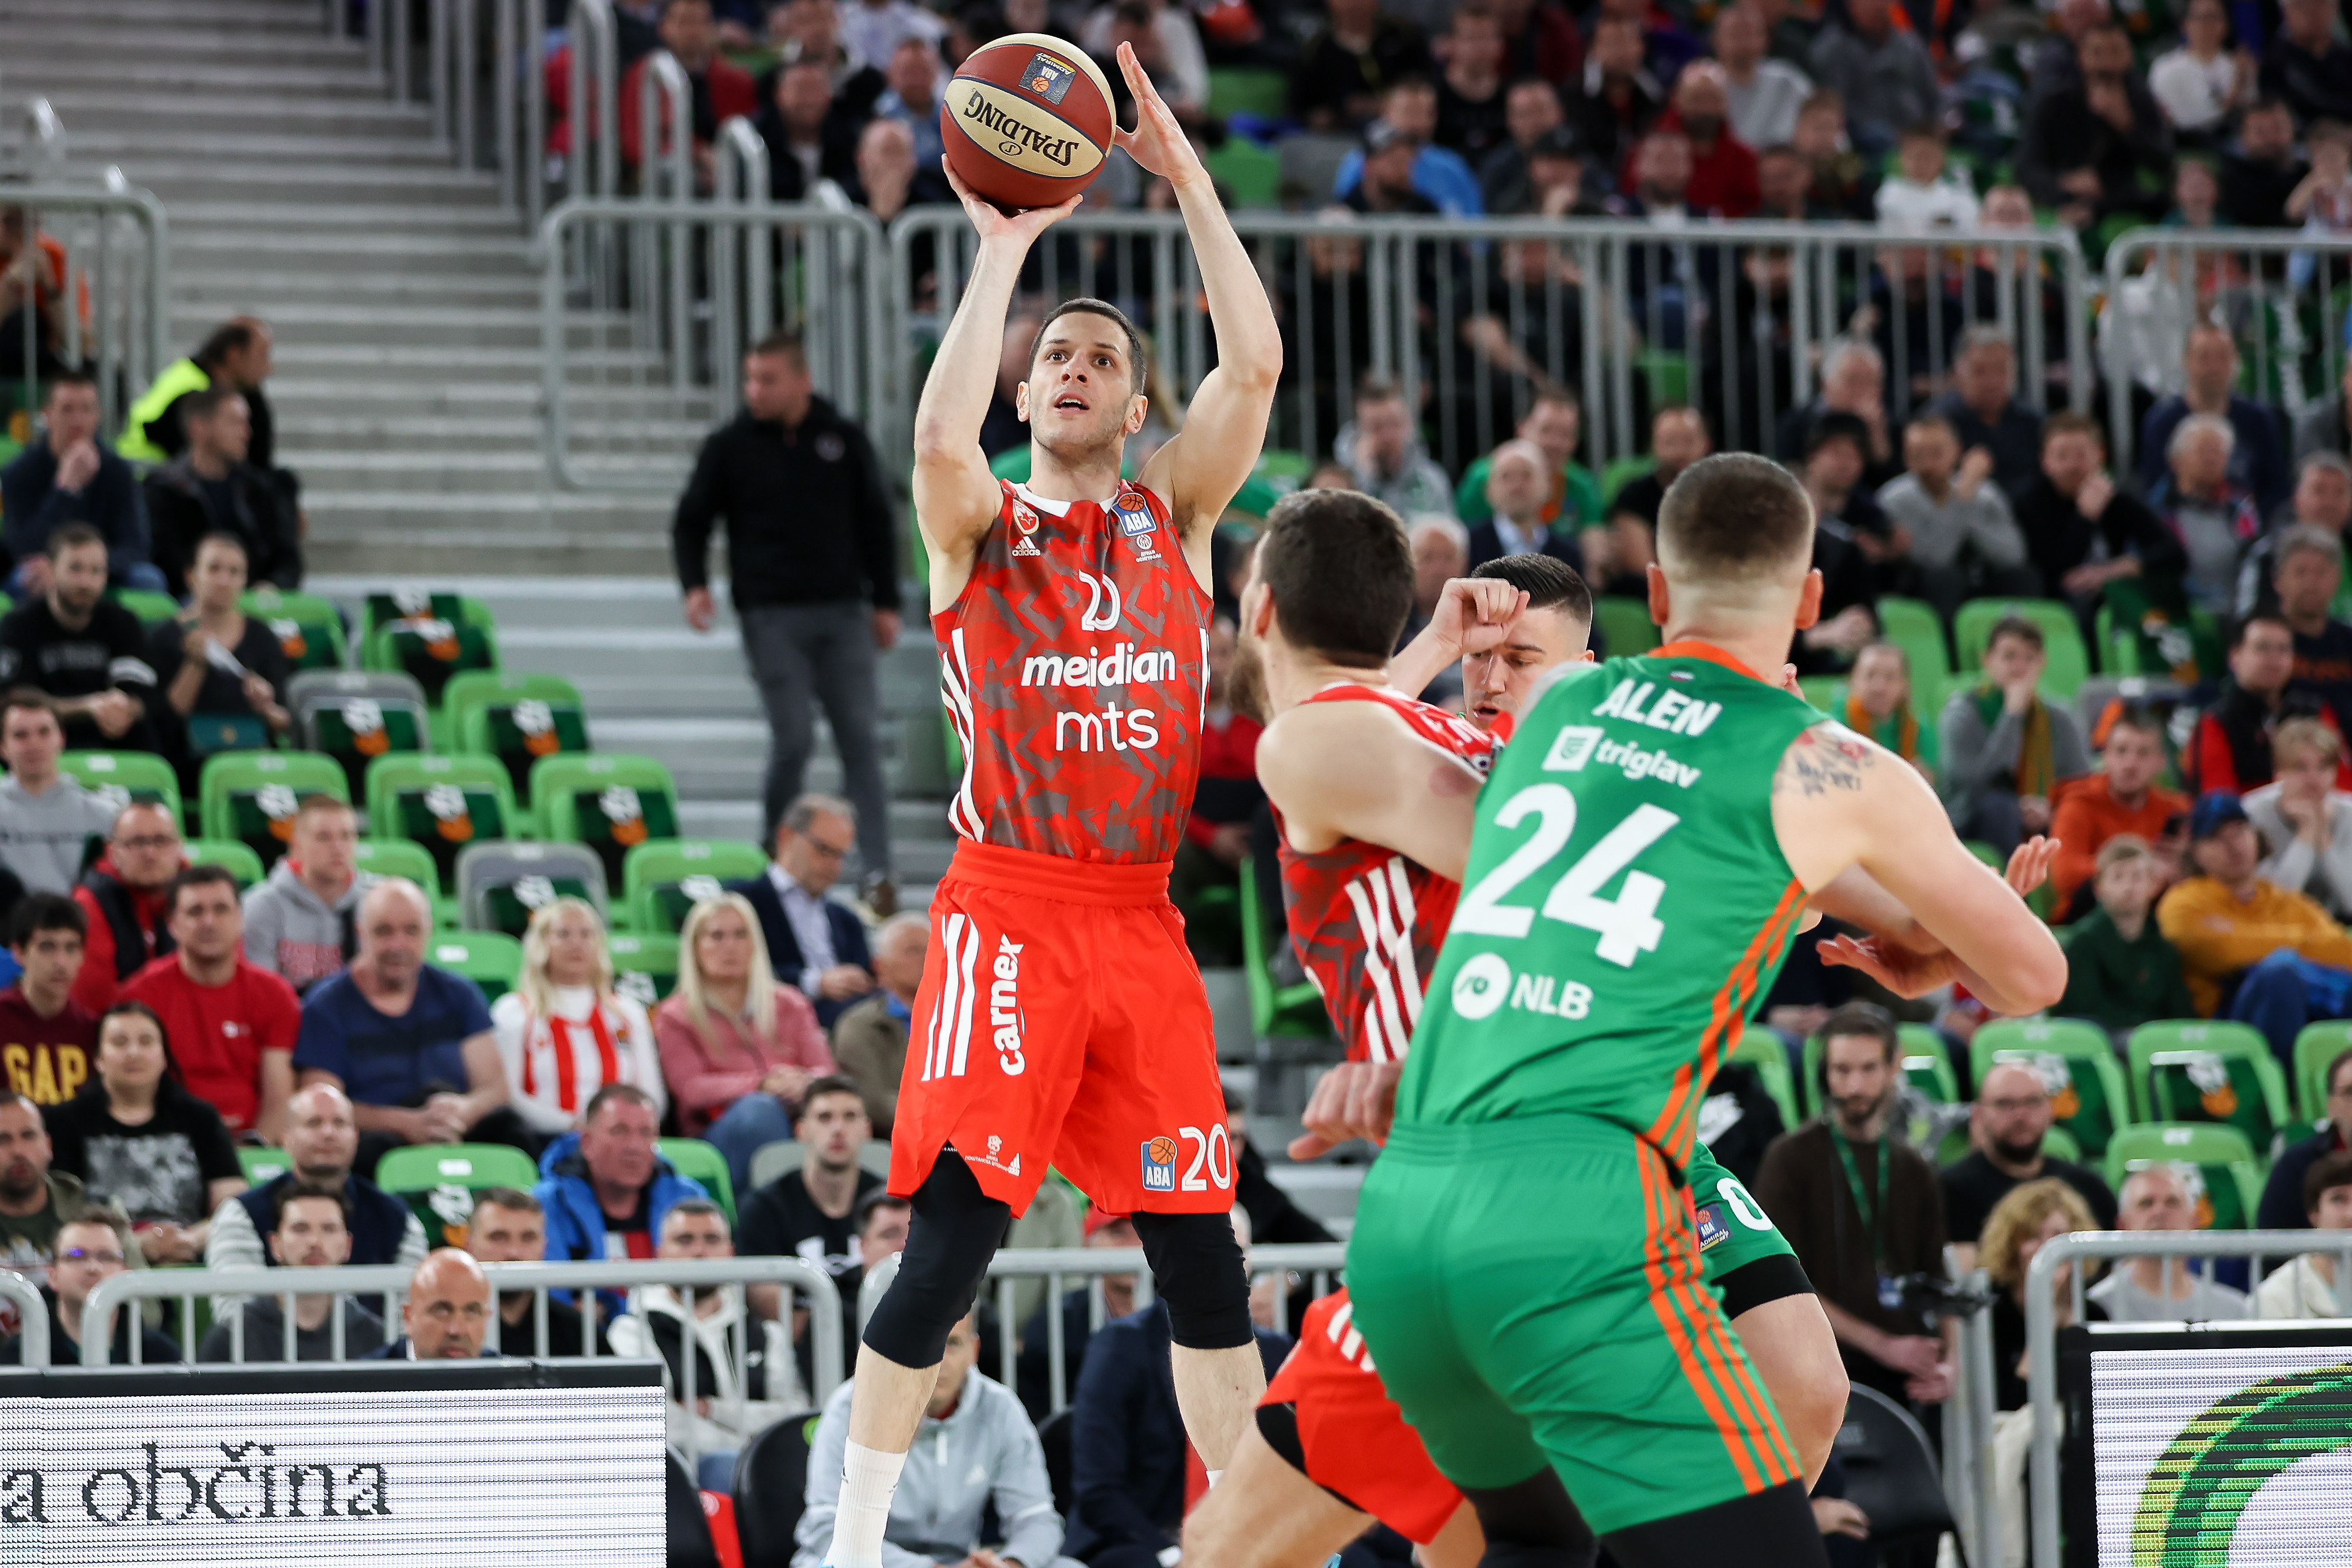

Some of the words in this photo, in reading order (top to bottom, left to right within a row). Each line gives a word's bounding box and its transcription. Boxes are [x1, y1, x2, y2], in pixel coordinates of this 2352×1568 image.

[1036, 56, 1072, 75] ADMIRAL
[1041, 66, 1059, 81] ABA
[963, 88, 1079, 167] SPALDING
[1124, 512, 1153, 532] ABA
[1021, 641, 1176, 687] meidian
[1055, 701, 1159, 752] mts
[1591, 678, 1723, 736] ALEN
[1595, 738, 1701, 788] triglav
[1448, 782, 1680, 968] 24
[990, 933, 1024, 1075] carnex
[1509, 972, 1594, 1021] NLB
[3, 1042, 88, 1105] GAP
[1146, 1166, 1171, 1187] ABA
[1178, 1123, 1231, 1192] 20
[1700, 1228, 1726, 1249] ADMIRAL
[1701, 1221, 1716, 1237] ABA
[82, 1441, 392, 1525] občina
